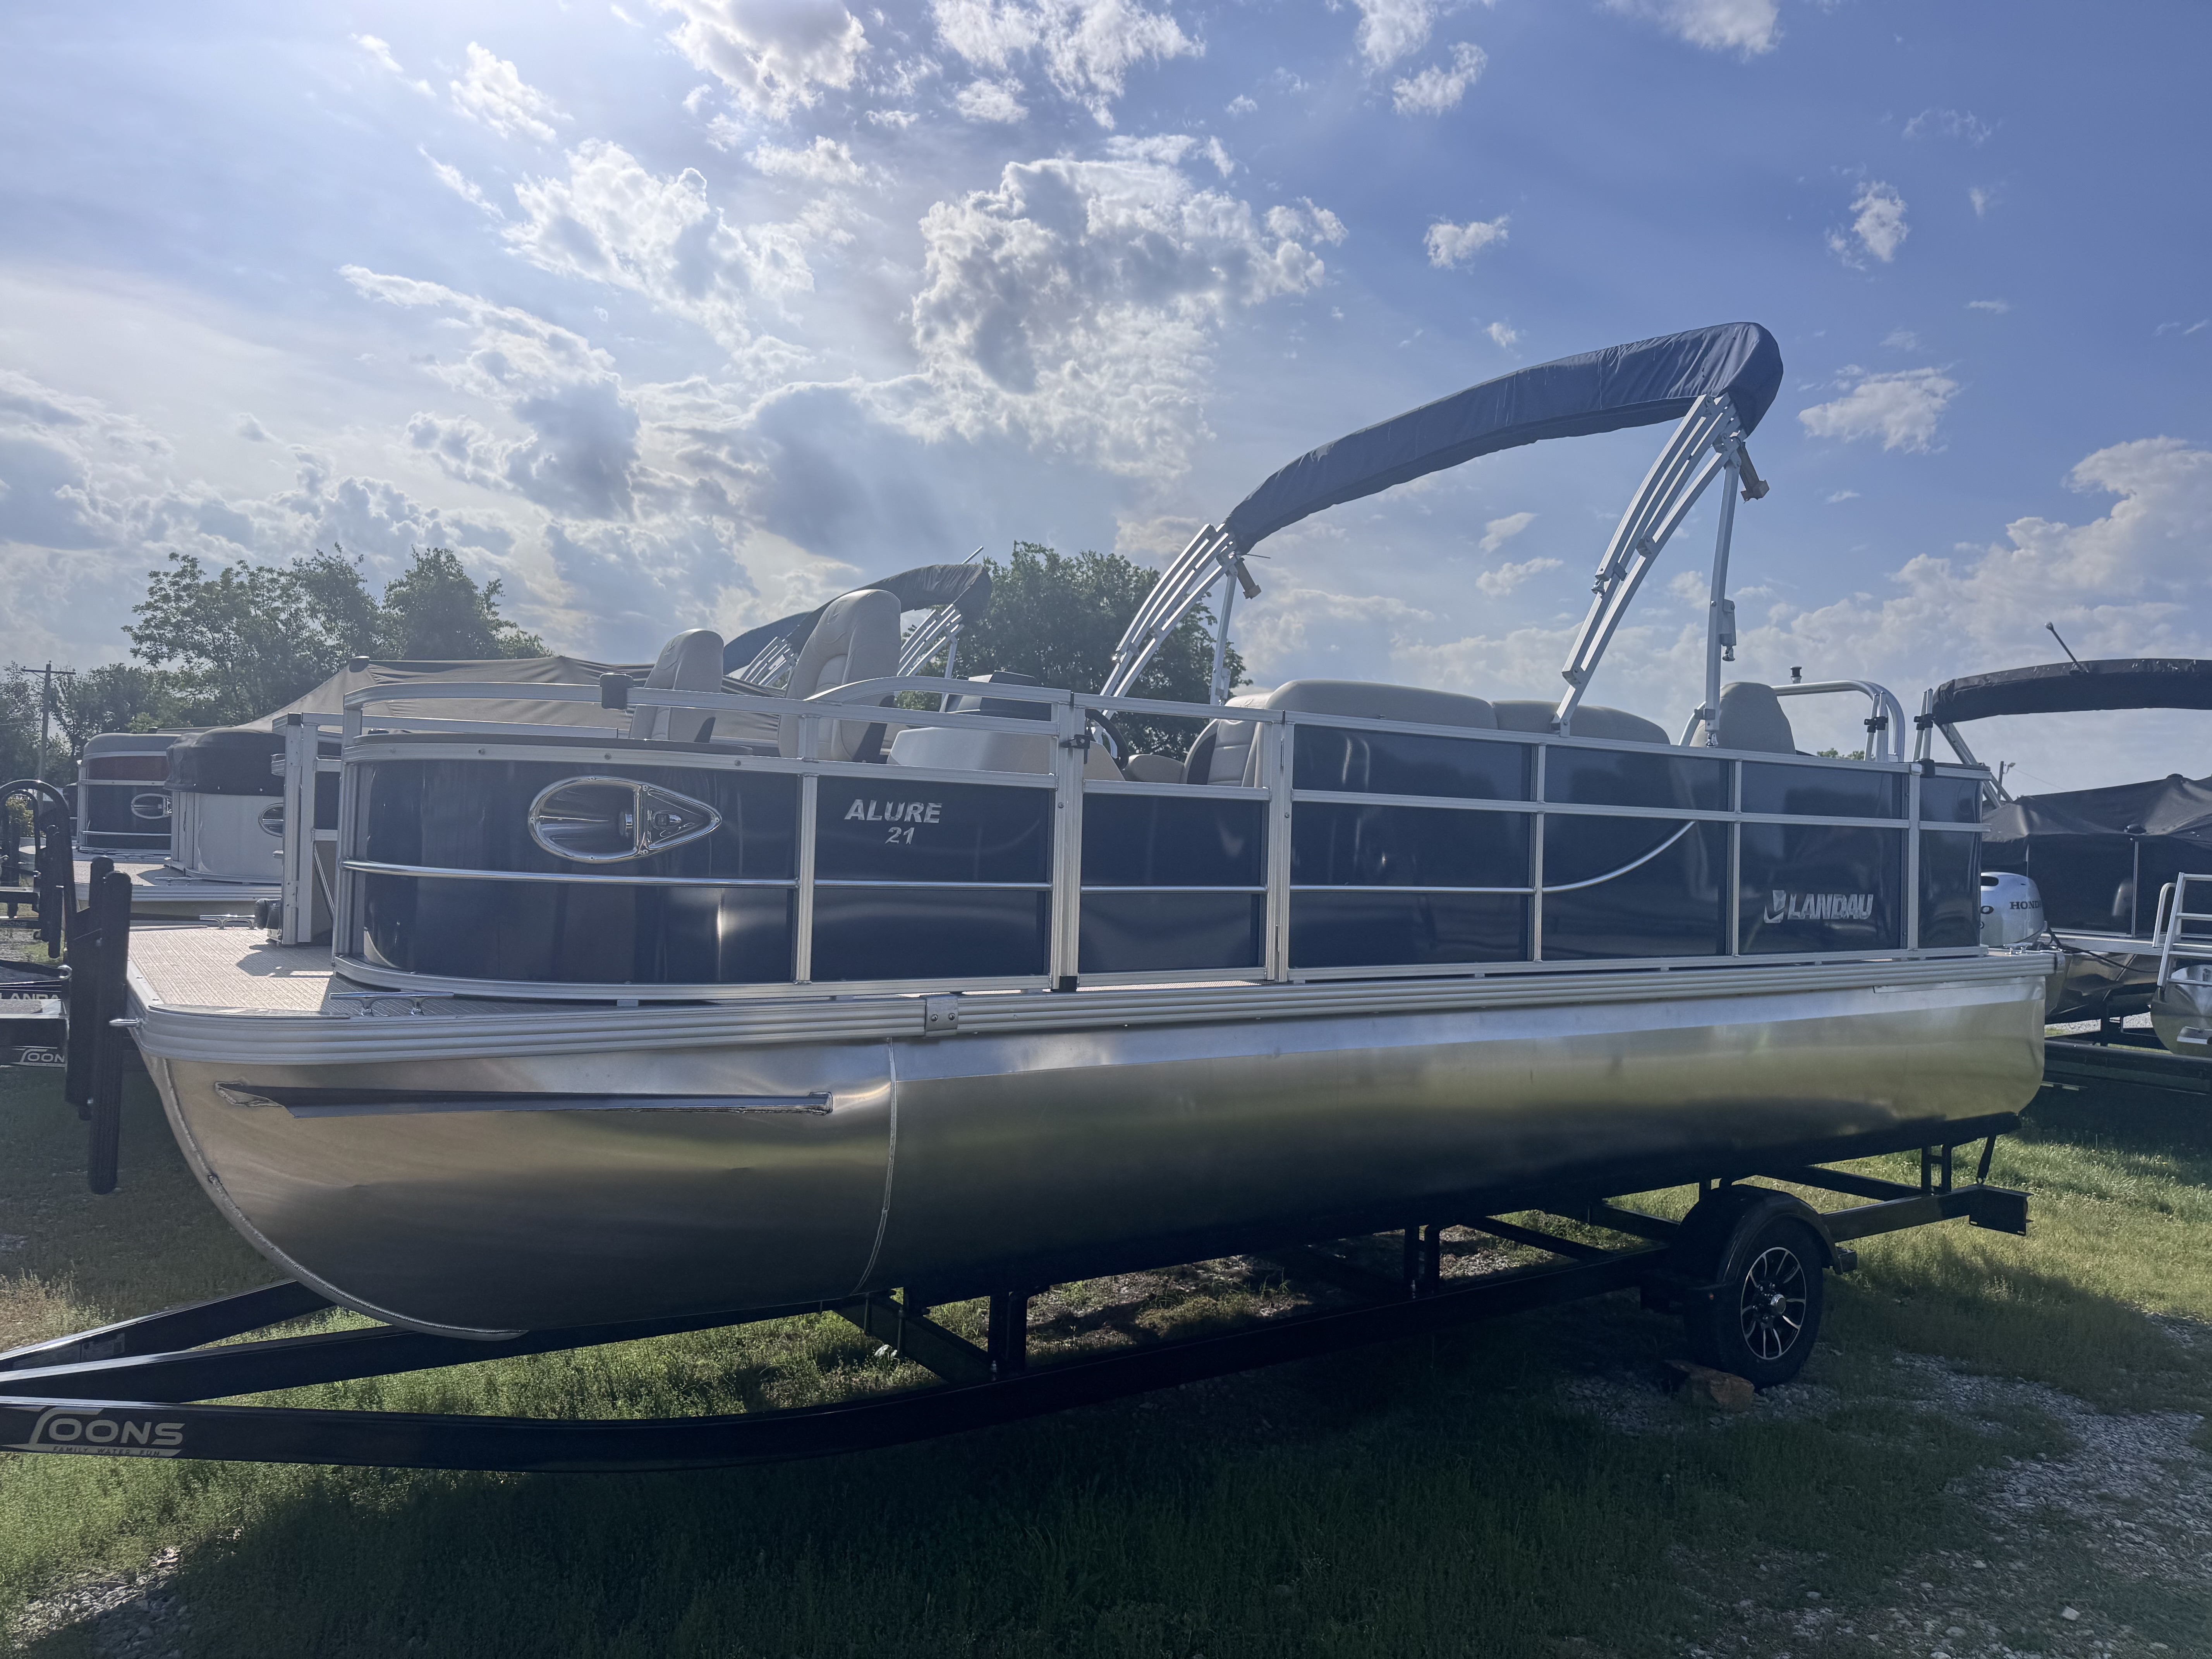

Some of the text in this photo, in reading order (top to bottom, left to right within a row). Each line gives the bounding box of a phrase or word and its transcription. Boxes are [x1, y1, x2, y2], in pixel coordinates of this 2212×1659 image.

[844, 799, 943, 823] ALURE
[885, 827, 915, 845] 21
[1787, 893, 1874, 920] LANDAU
